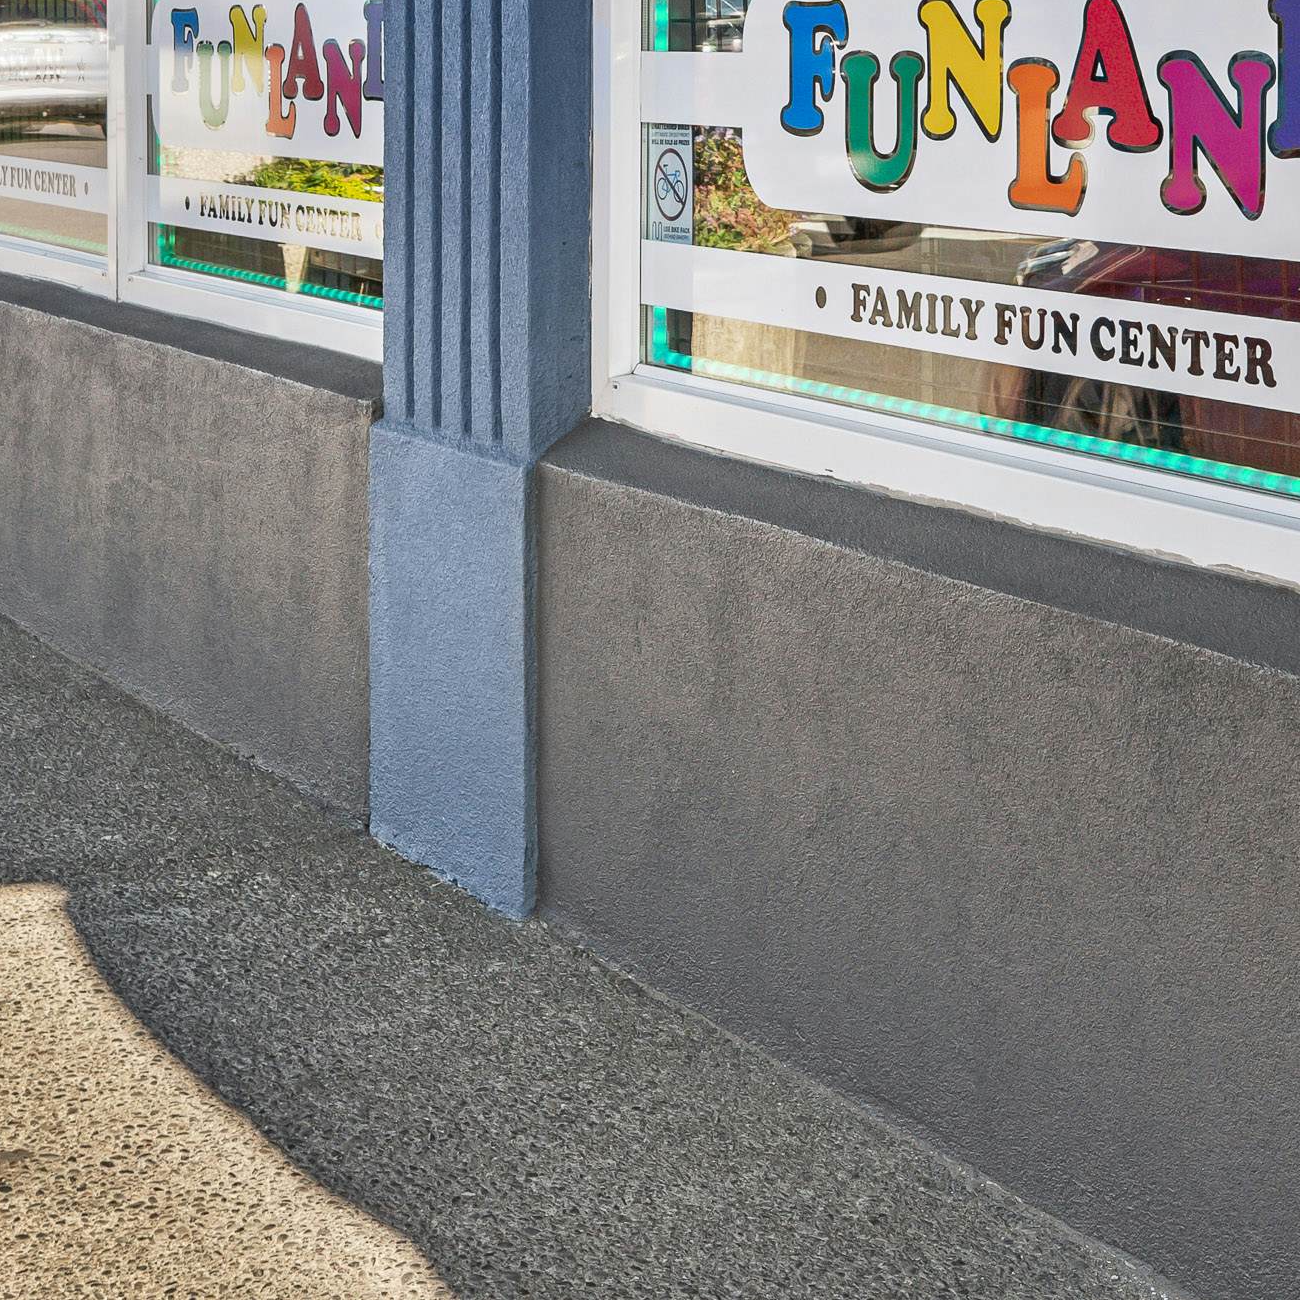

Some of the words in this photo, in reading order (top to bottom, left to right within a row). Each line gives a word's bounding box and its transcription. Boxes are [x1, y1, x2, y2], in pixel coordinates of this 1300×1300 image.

[10, 166, 33, 189] FUN
[34, 170, 78, 198] CENTER
[199, 194, 254, 225] FAMILY
[257, 199, 291, 230] FUN
[295, 204, 364, 242] CENTER
[850, 282, 986, 341] FAMILY
[993, 301, 1081, 357] FUN
[1089, 315, 1278, 388] CENTER
